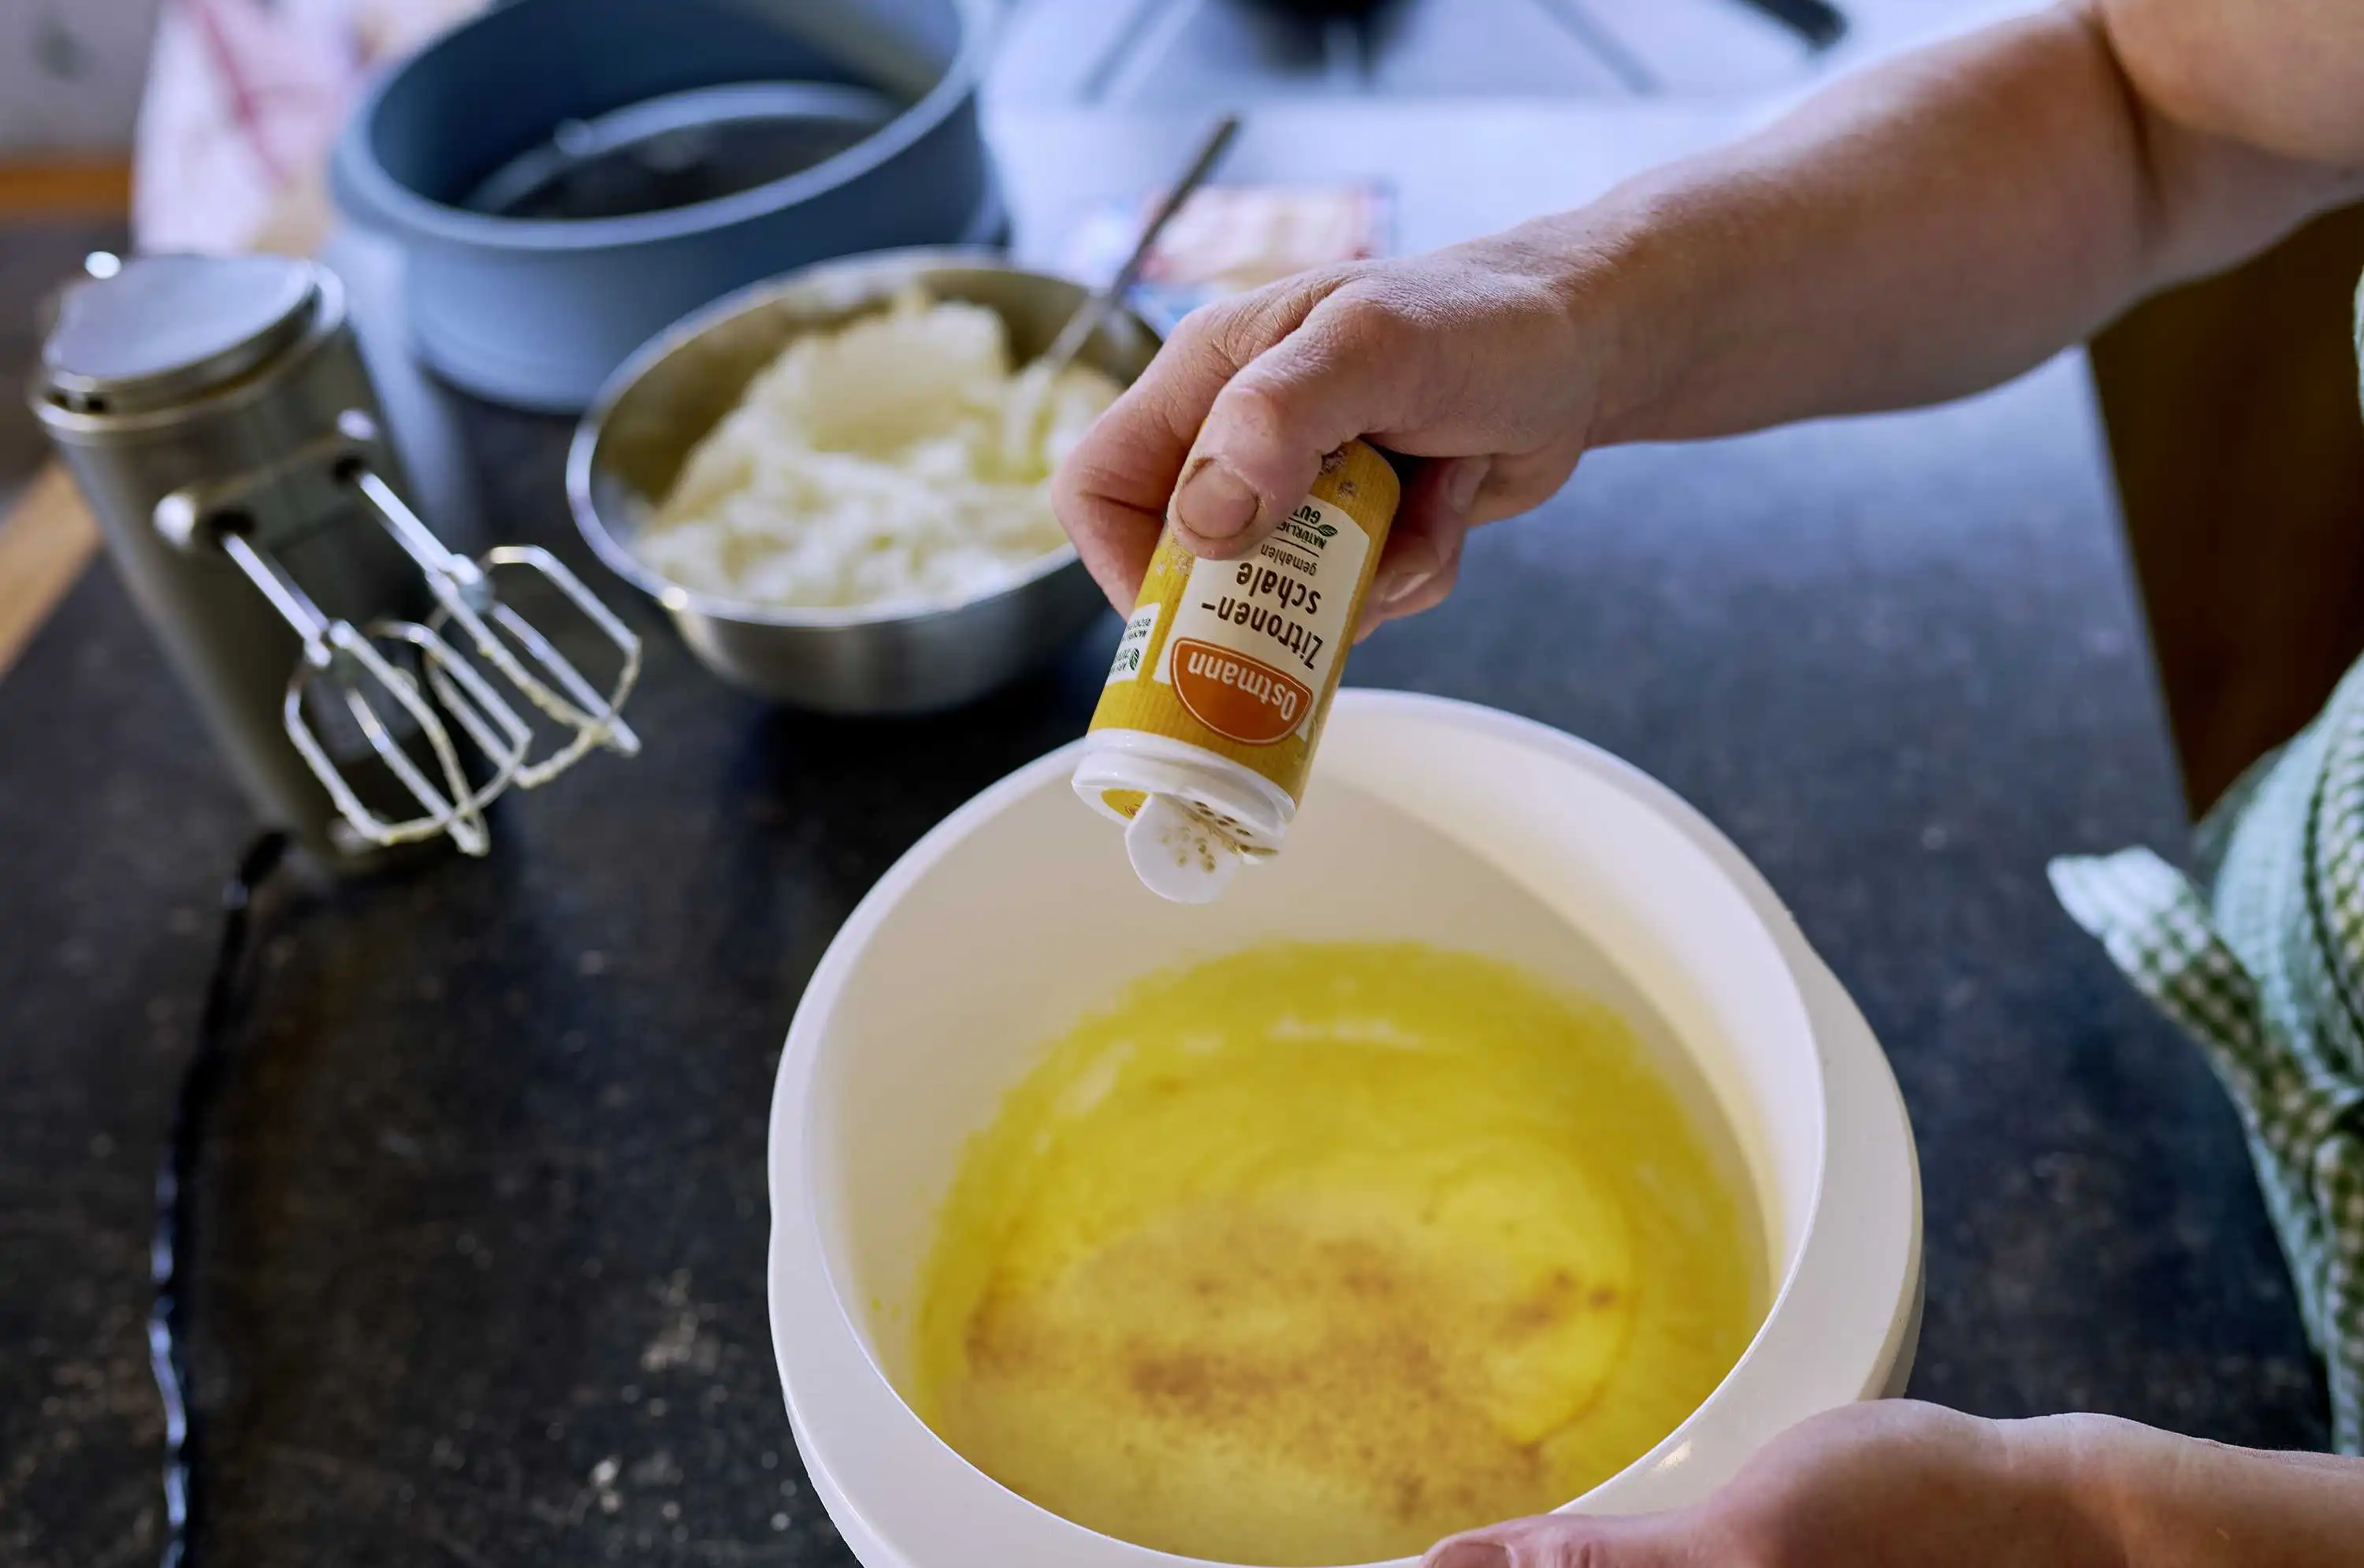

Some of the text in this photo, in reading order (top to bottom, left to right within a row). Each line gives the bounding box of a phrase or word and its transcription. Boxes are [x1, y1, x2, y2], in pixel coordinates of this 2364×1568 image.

[1276, 522, 1327, 550] NATÜRLIC
[1292, 505, 1321, 524] GUT
[1261, 543, 1318, 576] gemahlen
[1236, 562, 1321, 615] schale
[1202, 596, 1323, 670] Zitronen-
[1187, 651, 1297, 722] Ostmann
